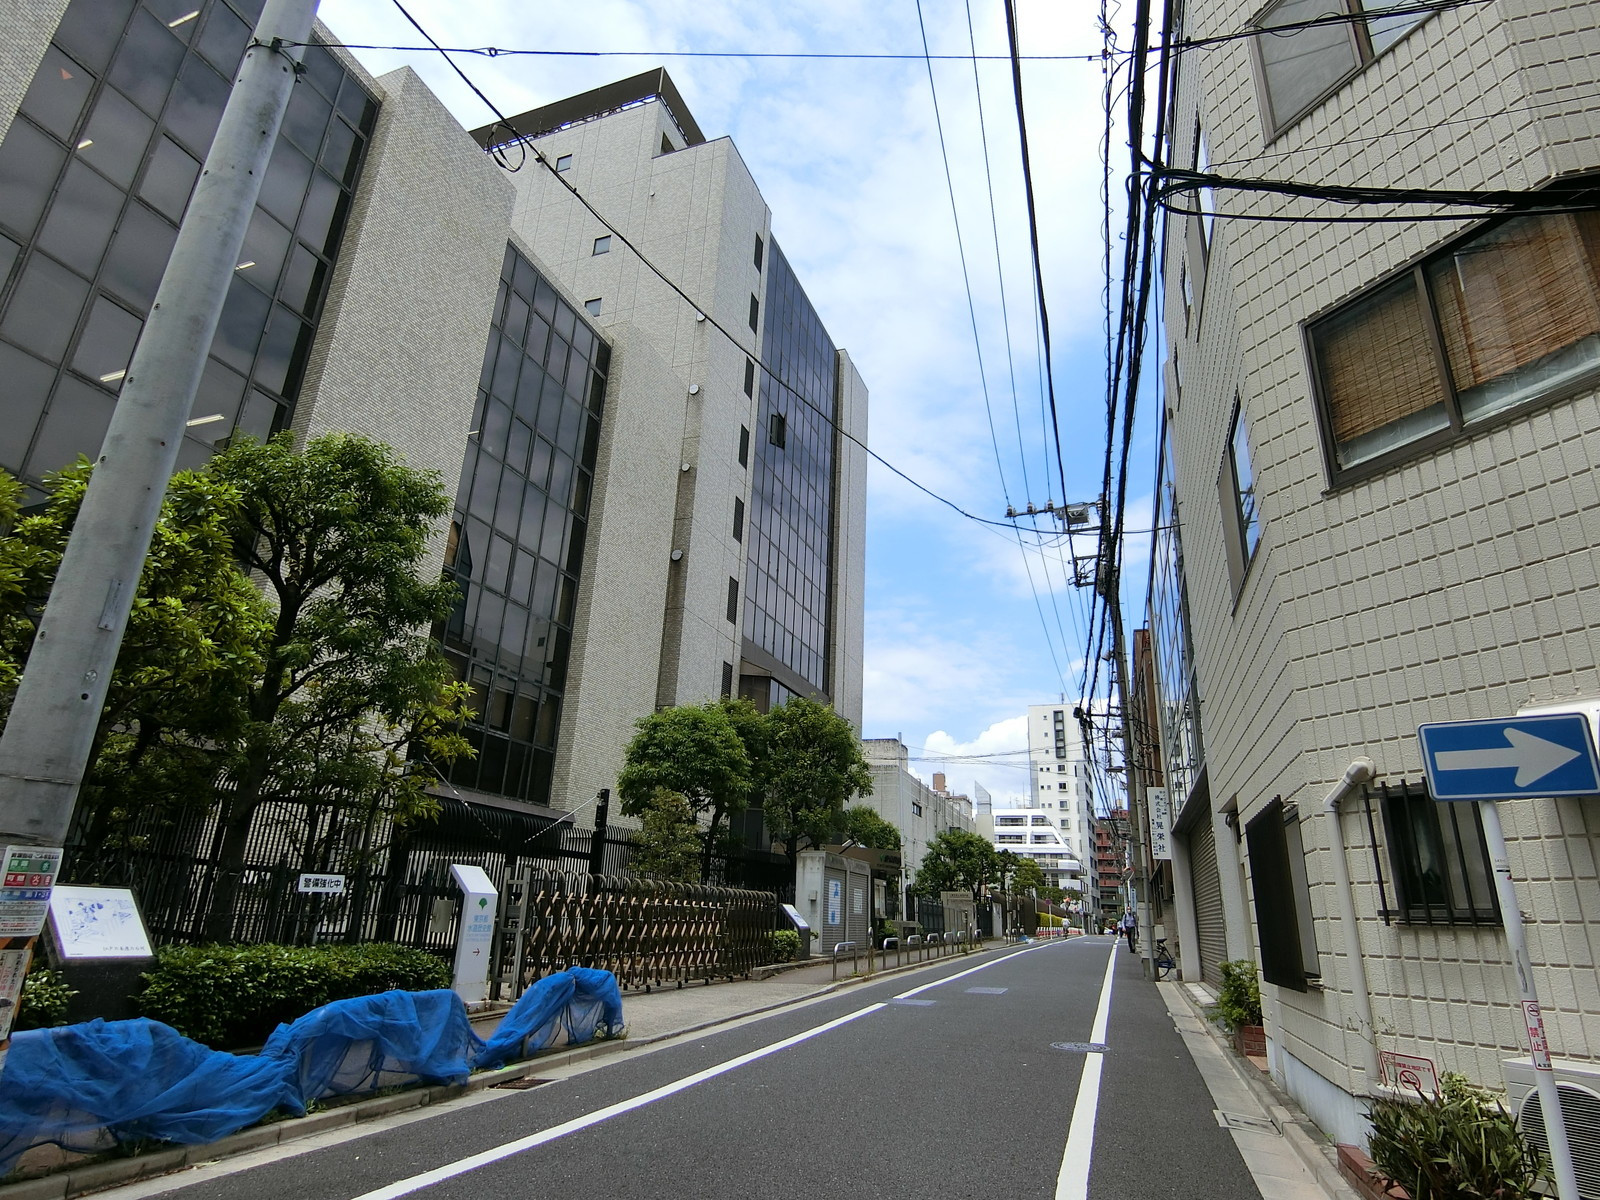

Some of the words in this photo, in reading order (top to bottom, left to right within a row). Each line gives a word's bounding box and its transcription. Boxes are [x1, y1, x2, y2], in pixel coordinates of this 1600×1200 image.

[303, 877, 342, 888] 警備強化中
[1529, 1026, 1543, 1052] 禁止
